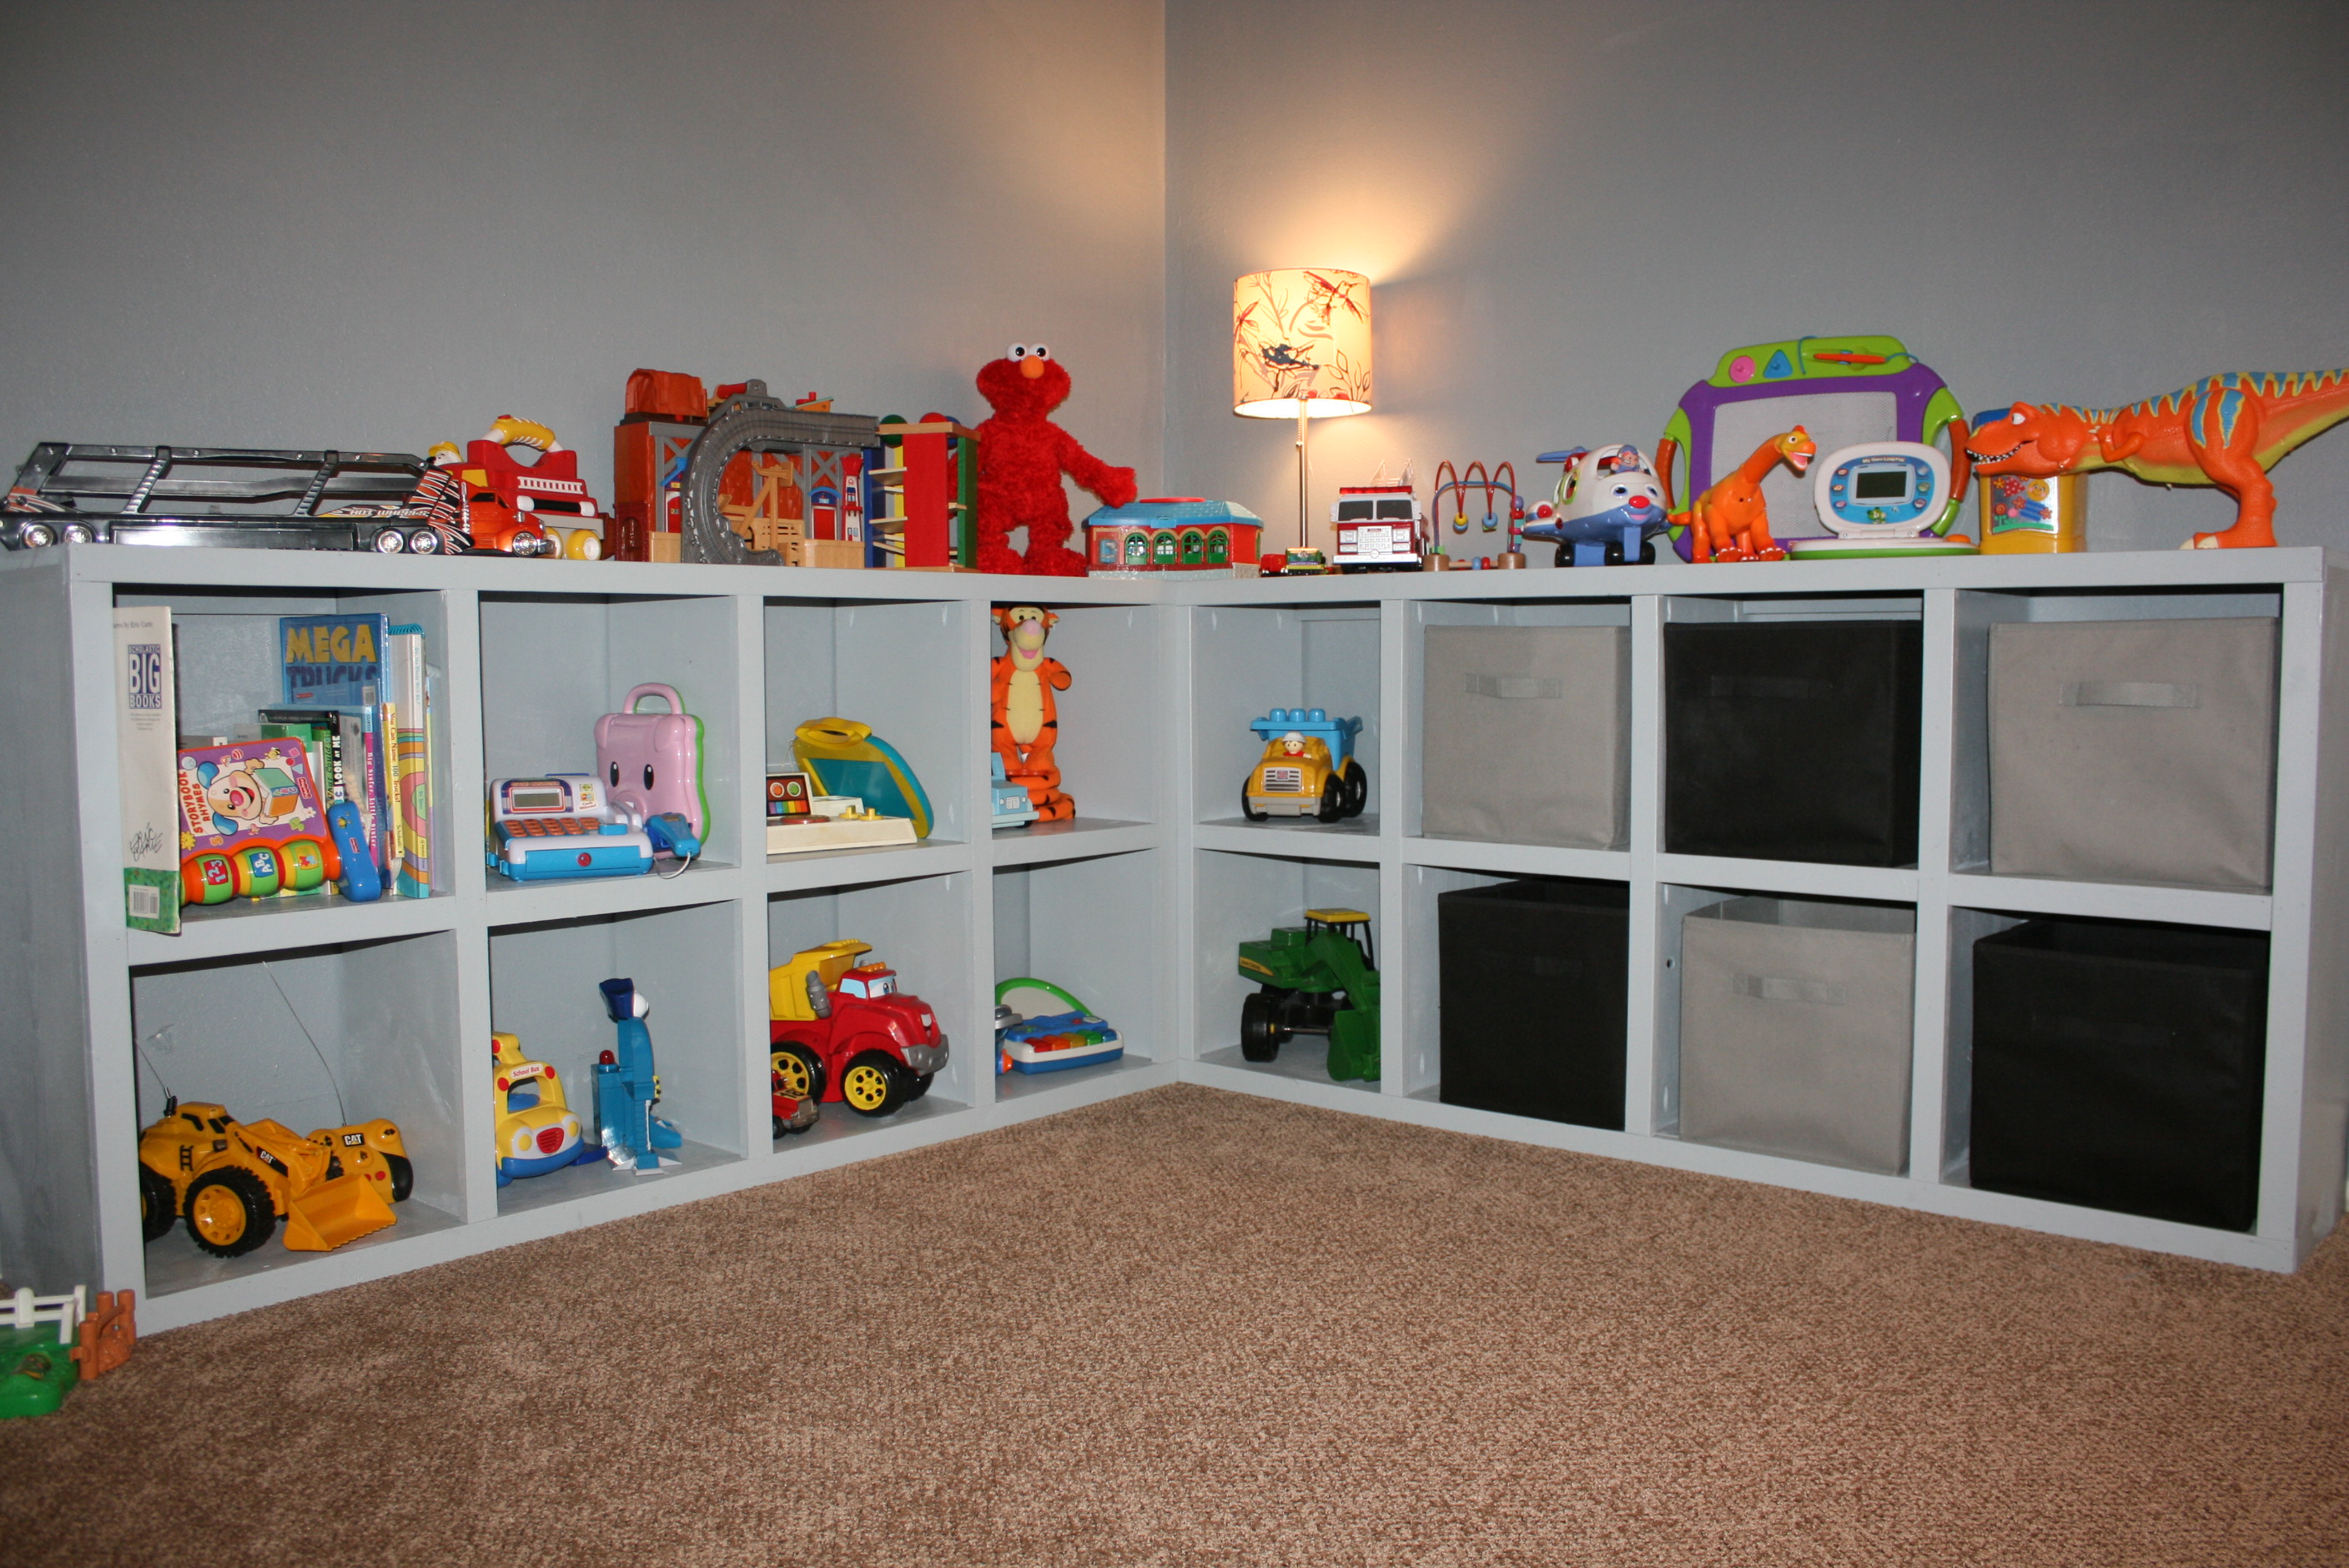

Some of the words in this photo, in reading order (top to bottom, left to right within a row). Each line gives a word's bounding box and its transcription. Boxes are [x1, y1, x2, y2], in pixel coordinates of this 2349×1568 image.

[285, 623, 377, 664] MEGA
[128, 653, 161, 694] BIG
[130, 694, 162, 708] BOOKS
[332, 735, 340, 748] ME
[324, 746, 333, 772] Could
[333, 760, 343, 785] LOOK
[178, 771, 204, 834] STORYBOOK
[192, 783, 211, 822] RHYMES
[208, 859, 226, 882] 123
[254, 852, 273, 873] ABC
[513, 1068, 530, 1077] School
[344, 1133, 362, 1146] CAT
[259, 1150, 274, 1164] CAT
